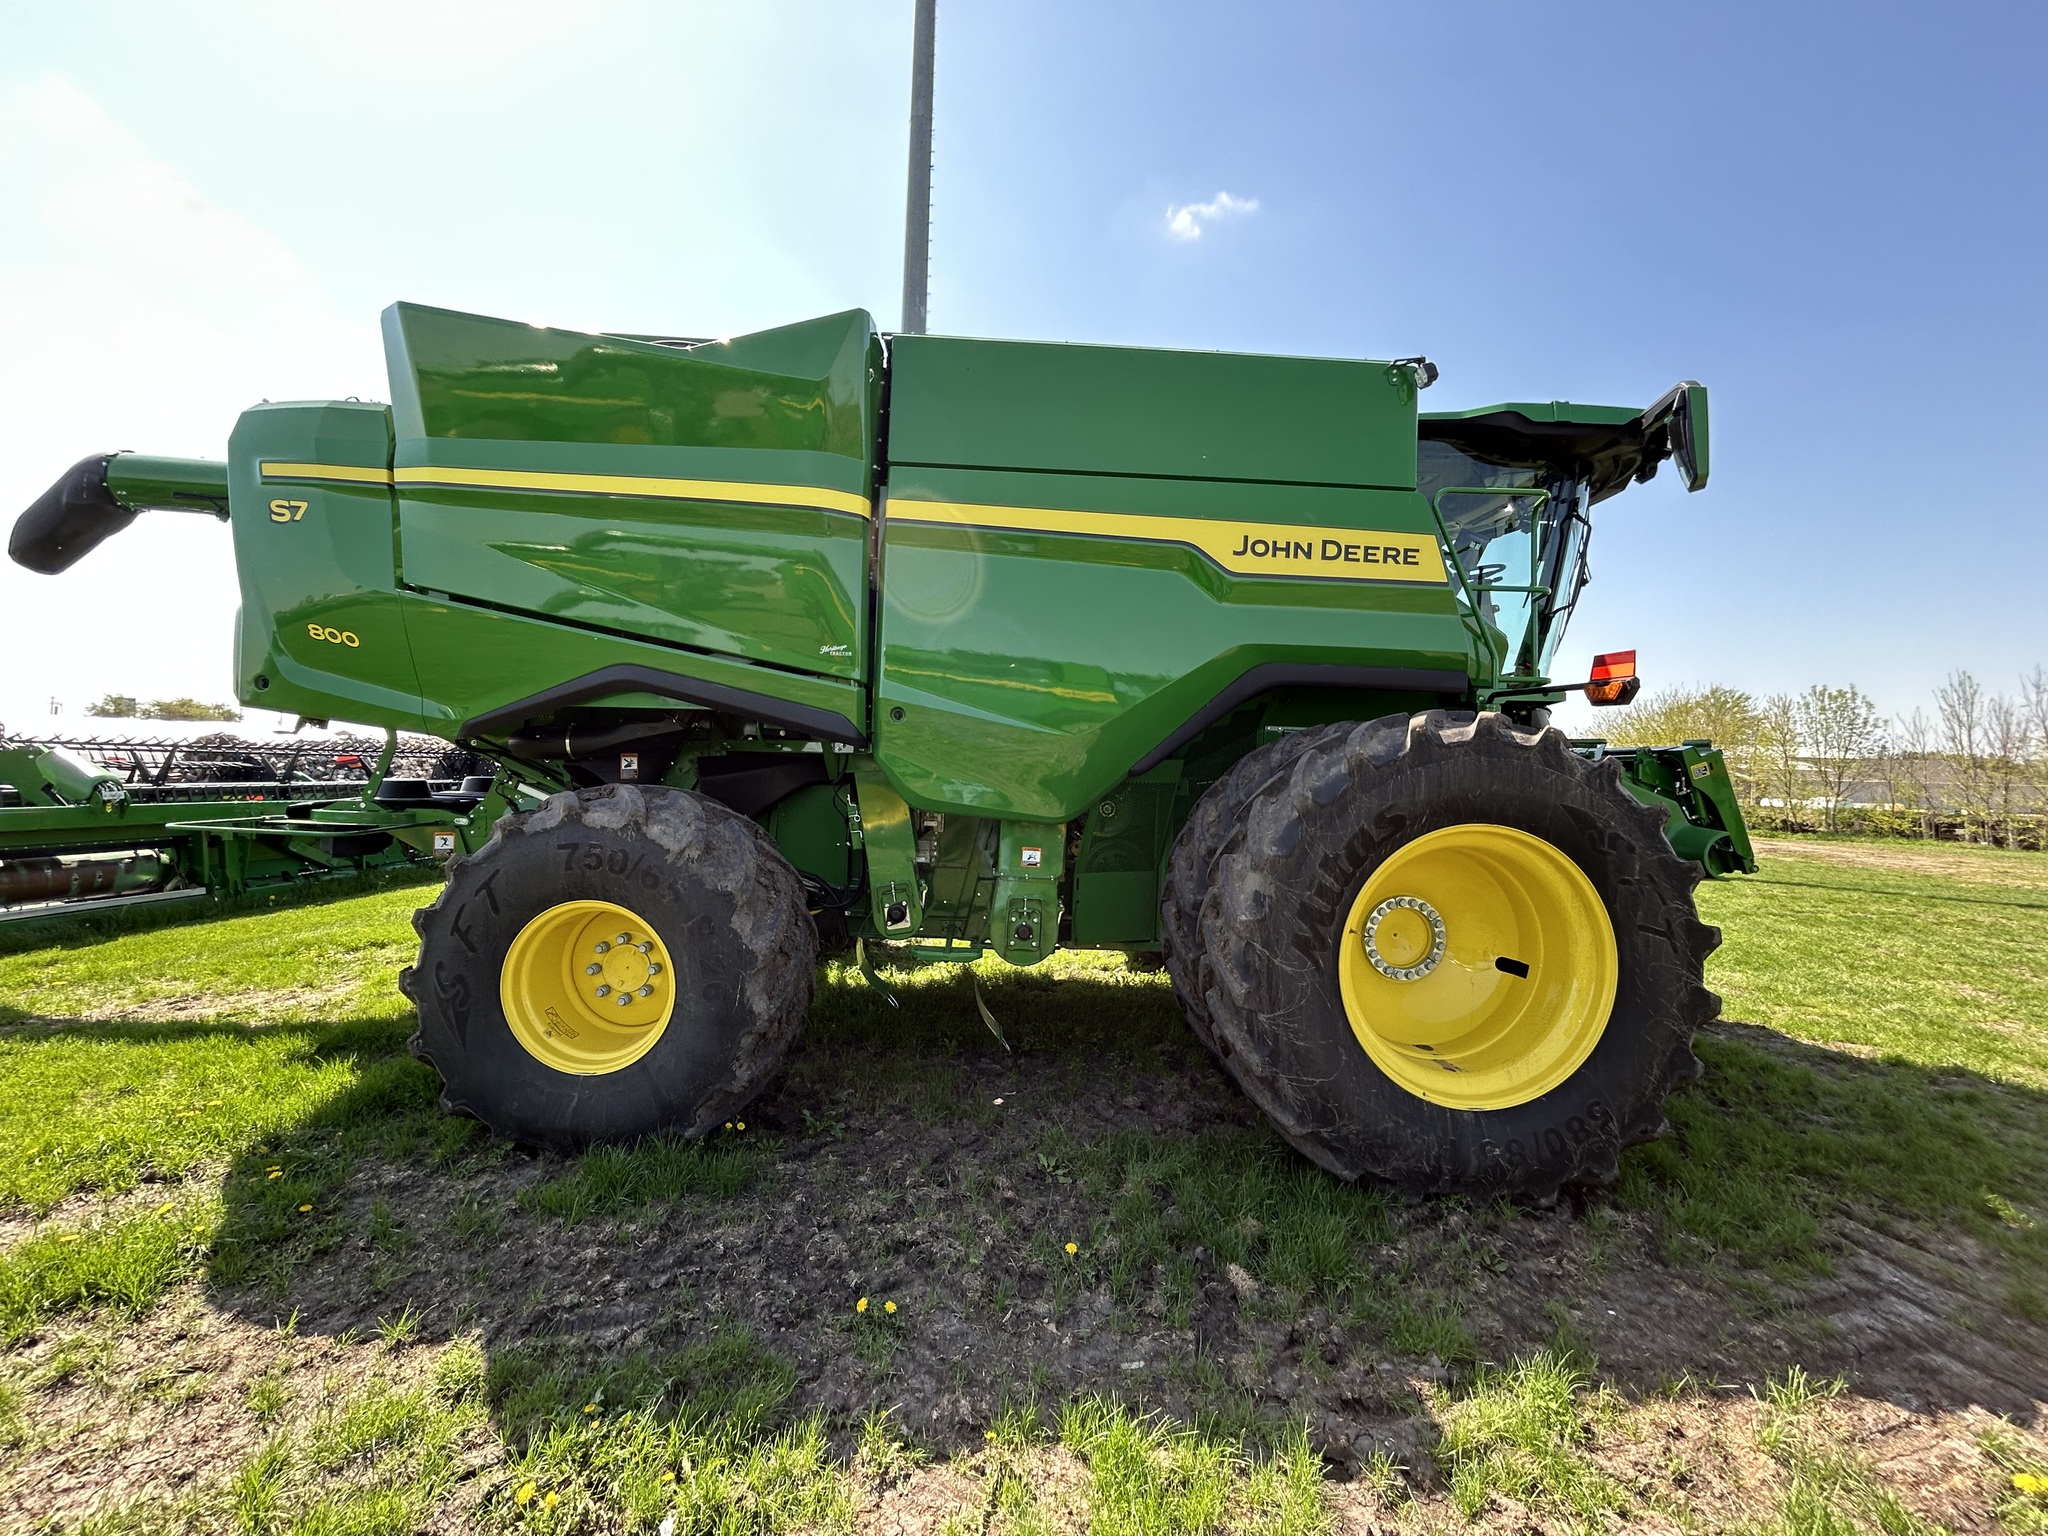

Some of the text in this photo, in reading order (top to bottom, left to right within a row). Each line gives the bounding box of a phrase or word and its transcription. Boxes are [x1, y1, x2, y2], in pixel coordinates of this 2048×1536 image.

[269, 499, 309, 524] S7
[1232, 534, 1420, 566] JOHN DEERE
[307, 623, 361, 648] 800
[435, 867, 502, 1012] SFT
